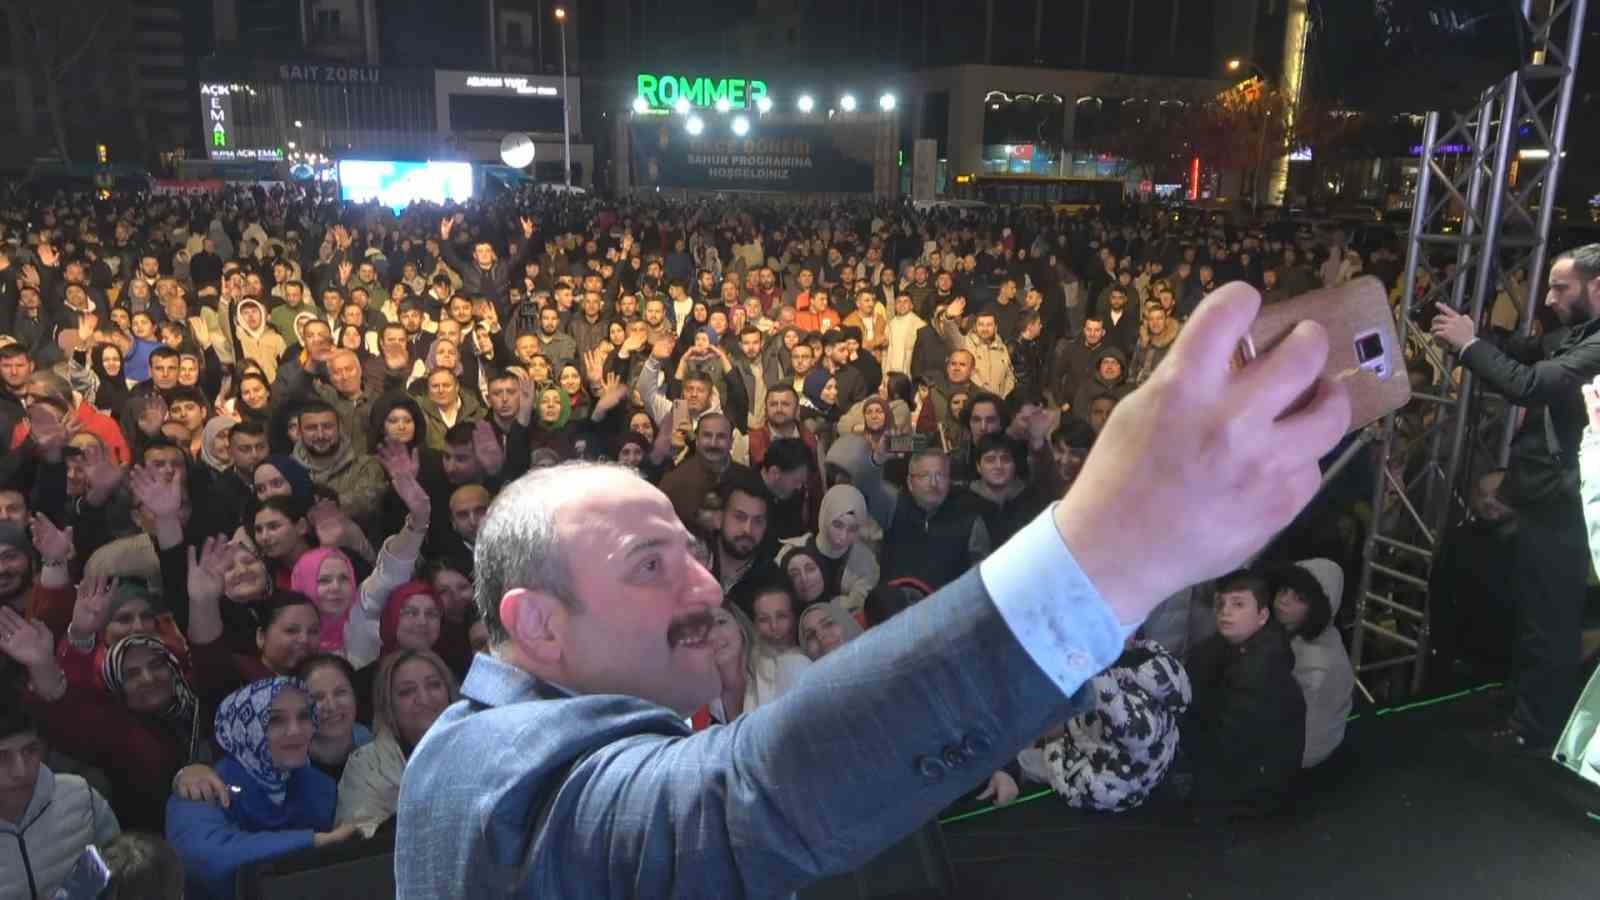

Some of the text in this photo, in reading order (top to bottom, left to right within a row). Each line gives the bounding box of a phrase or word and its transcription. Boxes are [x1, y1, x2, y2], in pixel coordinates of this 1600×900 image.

[325, 66, 380, 81] ZORLU
[201, 84, 230, 96] AÇIK
[688, 153, 813, 168] SAHUR PROGRAMINA
